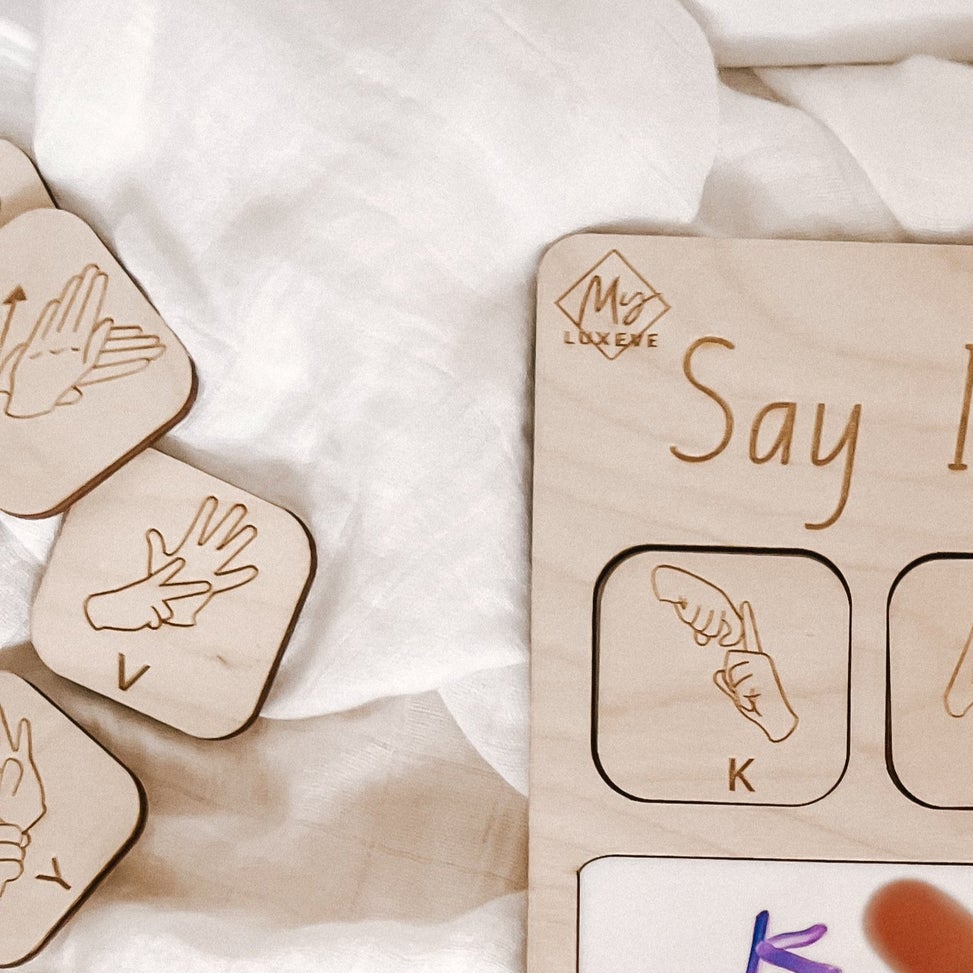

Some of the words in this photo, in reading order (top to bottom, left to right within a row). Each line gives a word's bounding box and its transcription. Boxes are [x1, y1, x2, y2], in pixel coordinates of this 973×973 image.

[577, 274, 664, 327] My
[563, 330, 659, 348] LUXEVE
[669, 335, 862, 530] Say
[117, 651, 151, 691] V
[728, 757, 756, 792] K
[35, 856, 72, 890] Y
